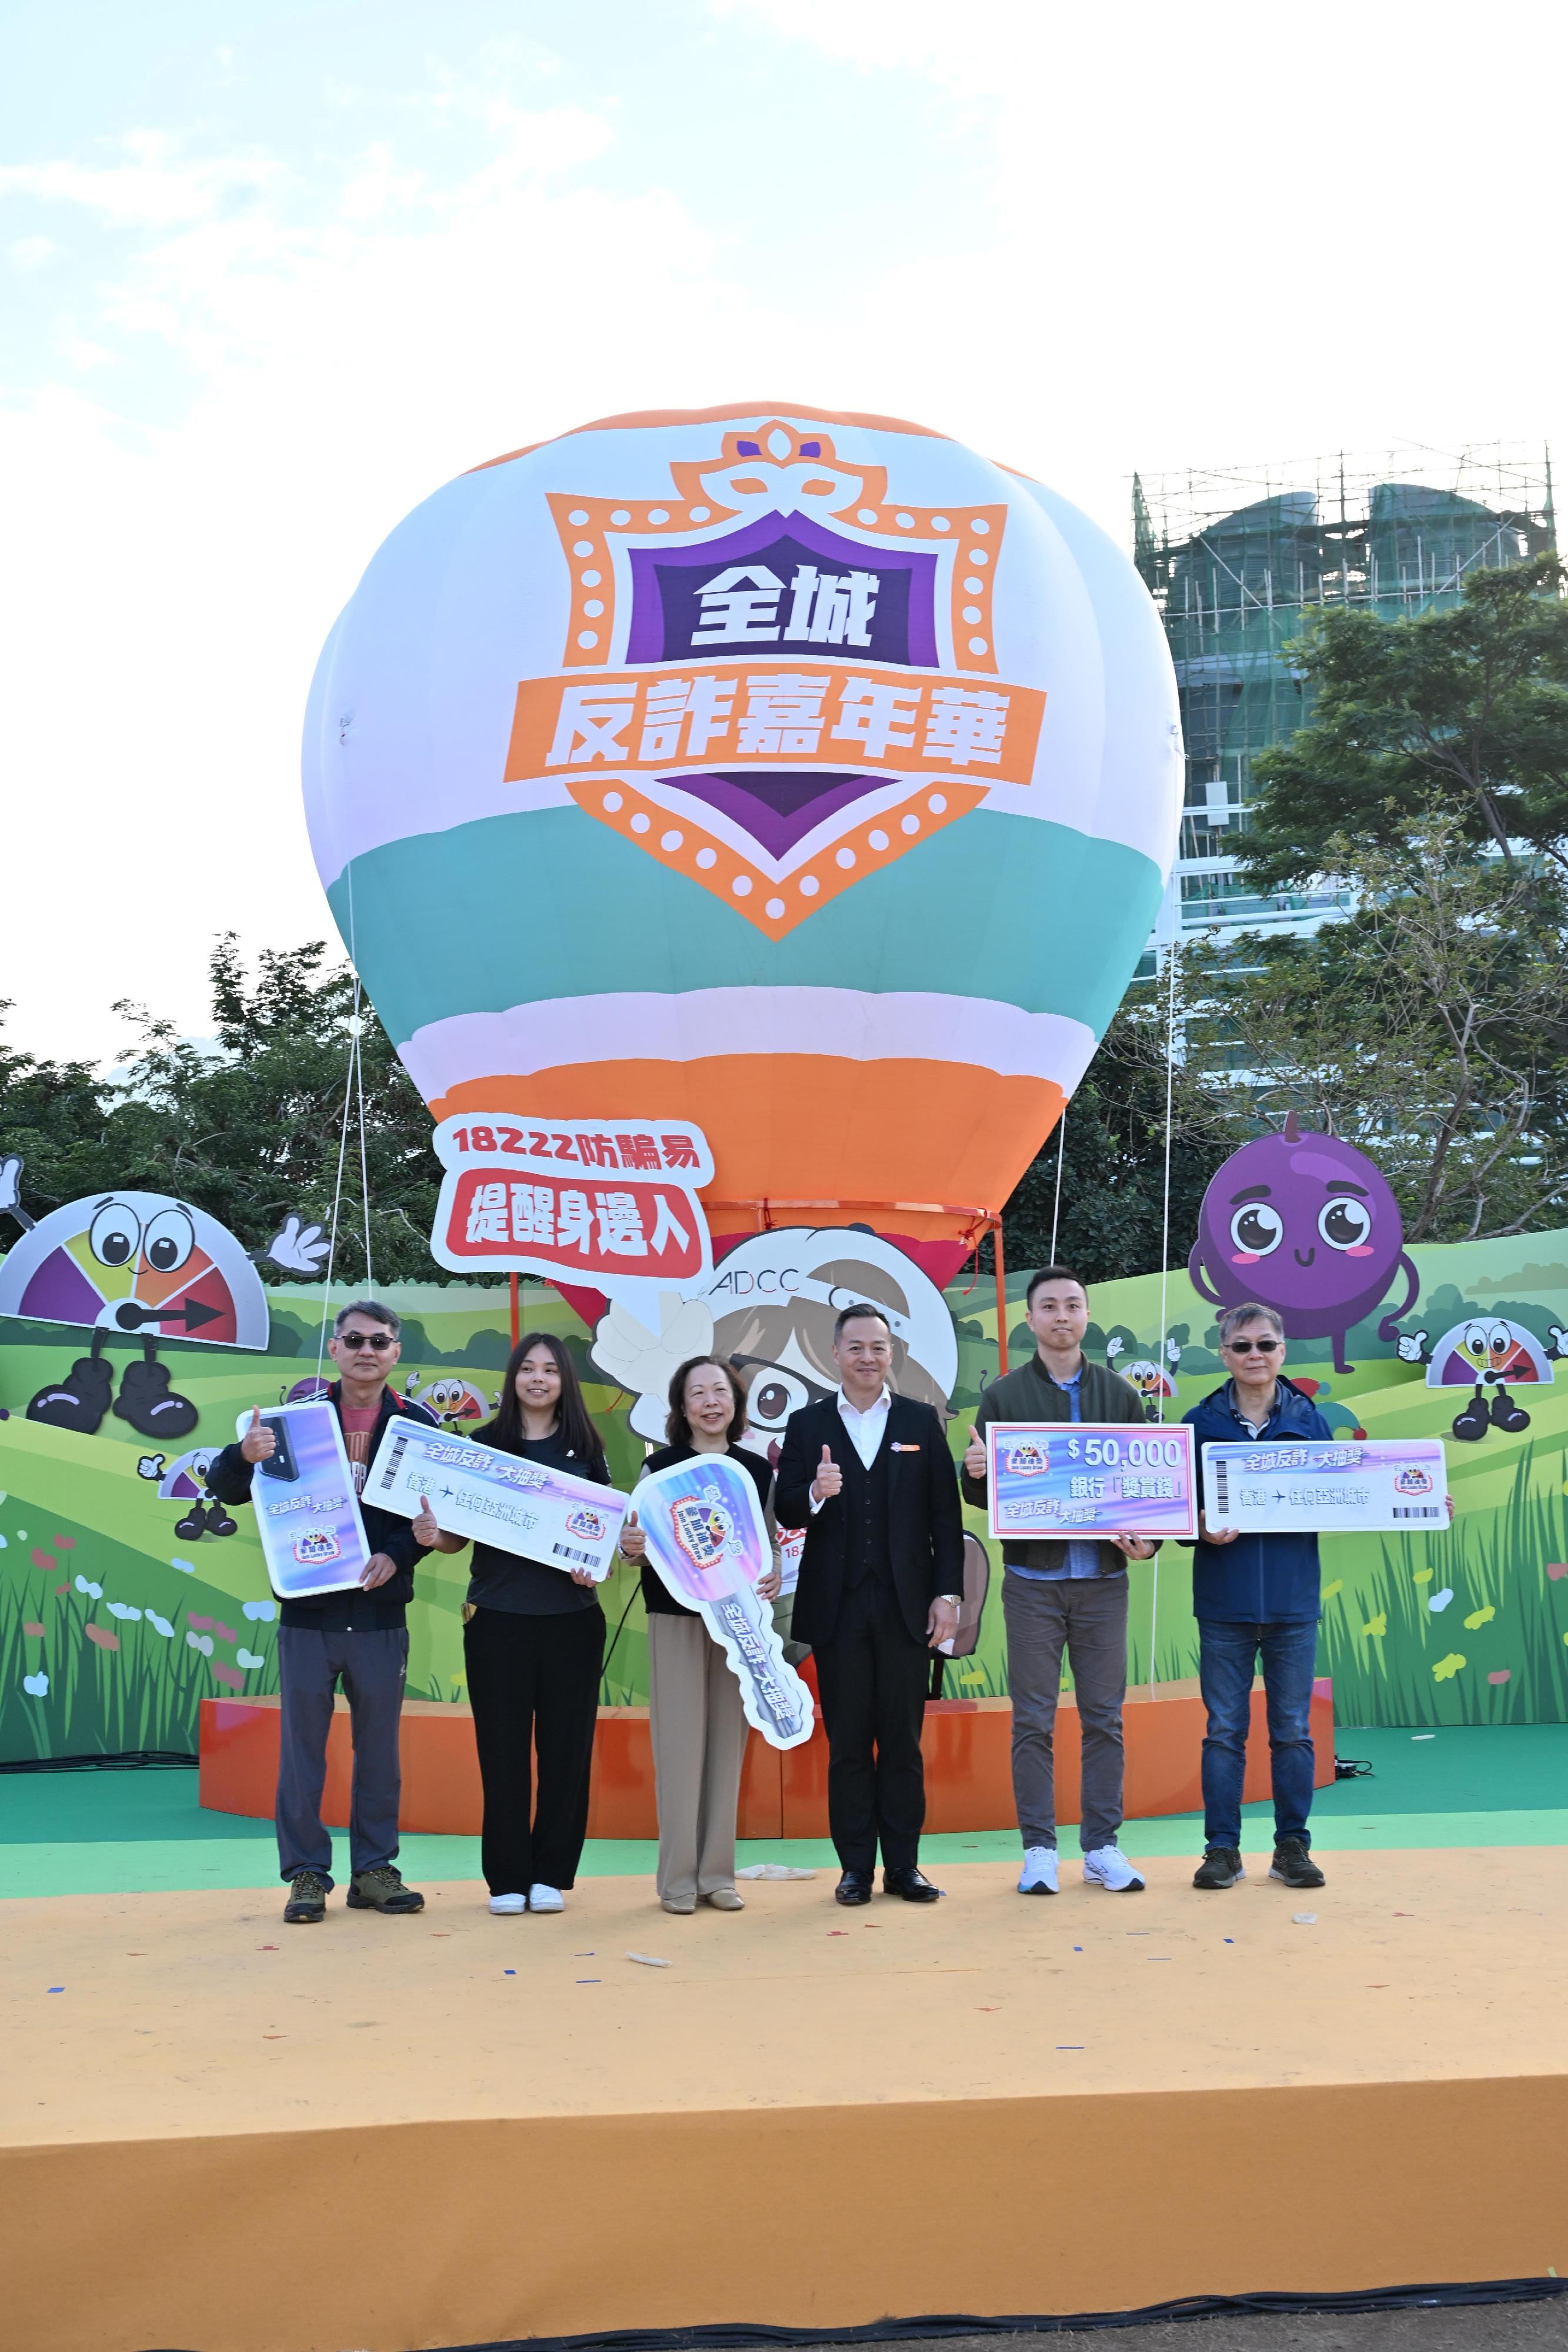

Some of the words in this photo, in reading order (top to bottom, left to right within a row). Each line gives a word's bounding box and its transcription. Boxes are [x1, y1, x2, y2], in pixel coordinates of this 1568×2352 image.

[690, 564, 880, 647] 全城
[546, 673, 1011, 767] 反詐嘉年華
[452, 1125, 701, 1170] 18222防騙易
[465, 1182, 691, 1258] 提醒身邊人
[708, 1268, 800, 1296] ADCC
[423, 1442, 494, 1472] 全城反詐
[497, 1465, 552, 1491] 大抽獎
[1067, 1438, 1182, 1472] $50,000
[1243, 1448, 1309, 1472] 全城反詐
[1316, 1447, 1369, 1468] 大抽獎
[268, 1495, 312, 1516] 全城反詐
[312, 1496, 346, 1515] 大抽獎
[406, 1472, 437, 1496] 香港
[456, 1488, 540, 1530] 任何亞洲城市
[1006, 1498, 1061, 1519] 全城反詐
[1058, 1506, 1100, 1525] 大抽獎
[1239, 1488, 1267, 1506] 香港
[1289, 1488, 1370, 1506] 任何亞洲城市
[677, 1510, 686, 1524] Join
[683, 1524, 695, 1543] Lucky
[691, 1543, 704, 1560] Draw
[720, 1602, 768, 1665] 全城反詐
[754, 1666, 795, 1722] 大抽獎
